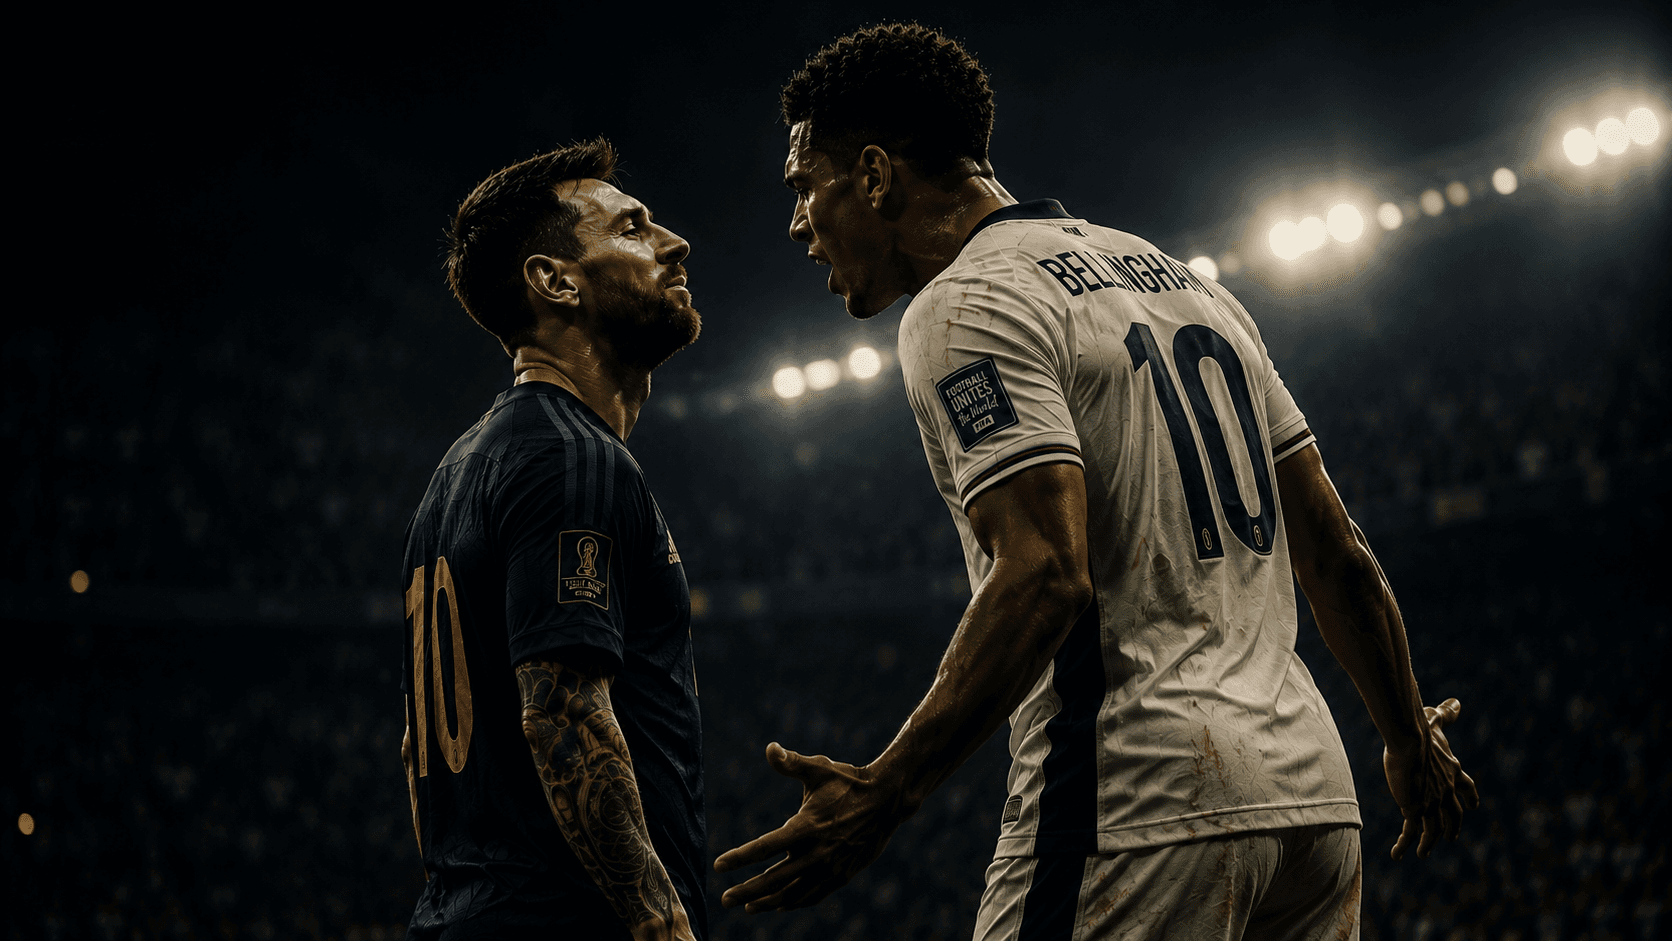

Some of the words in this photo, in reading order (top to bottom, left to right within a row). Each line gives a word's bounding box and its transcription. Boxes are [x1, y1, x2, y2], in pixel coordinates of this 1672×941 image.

[945, 370, 989, 400] FOOTBALL
[950, 380, 993, 413] UNITES
[1123, 321, 1277, 560] 10
[405, 555, 474, 778] 10
